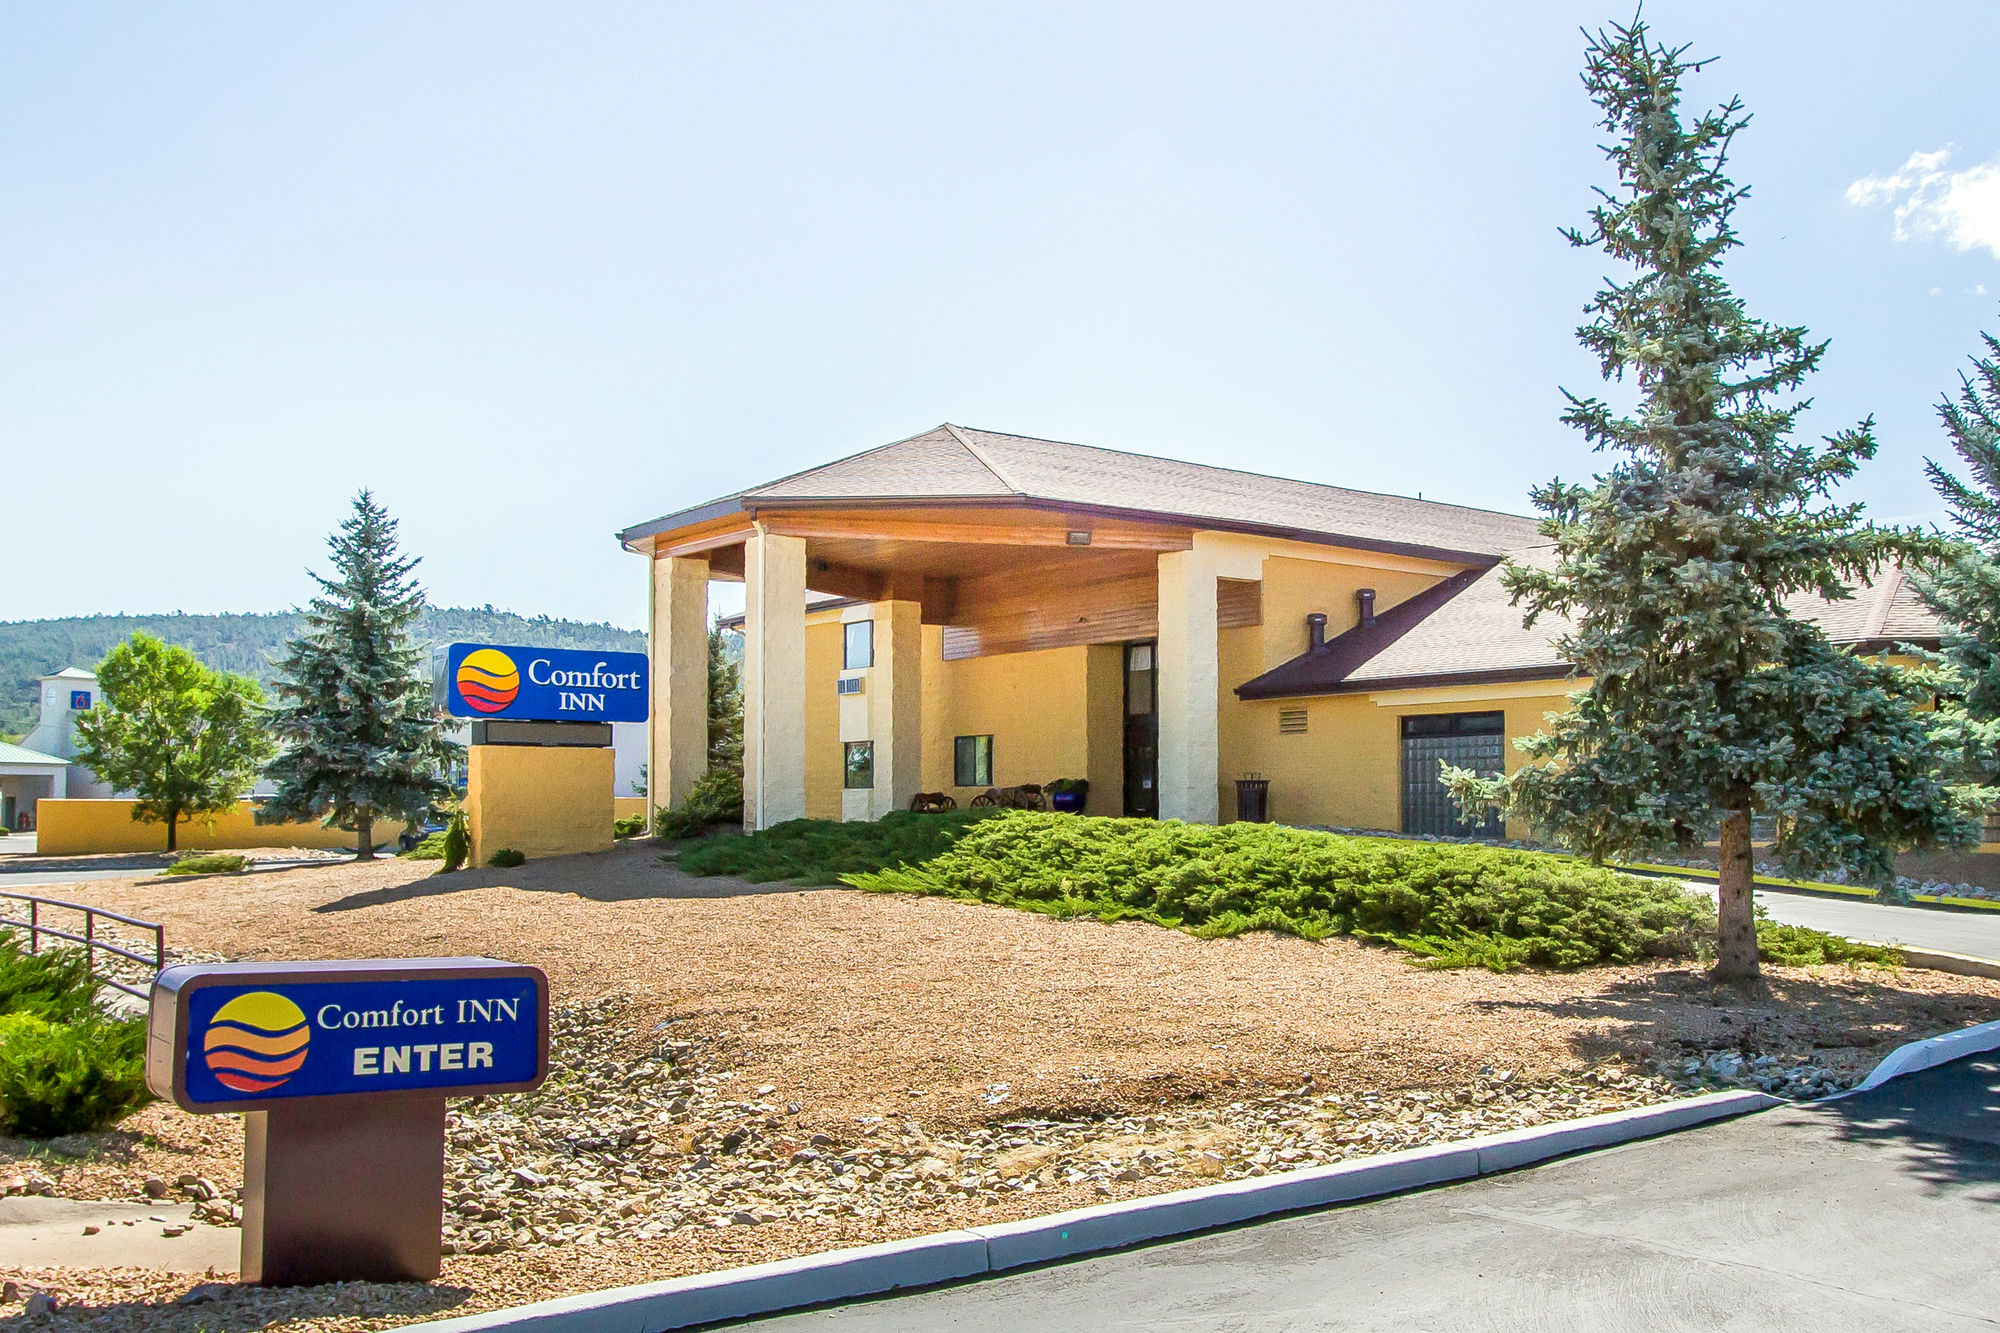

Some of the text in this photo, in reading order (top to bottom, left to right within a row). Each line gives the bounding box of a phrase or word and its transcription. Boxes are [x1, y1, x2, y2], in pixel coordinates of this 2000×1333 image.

[528, 658, 641, 690] Comfort
[559, 692, 605, 712] INN
[316, 998, 520, 1030] Comfort INN
[353, 1041, 493, 1076] ENTER
